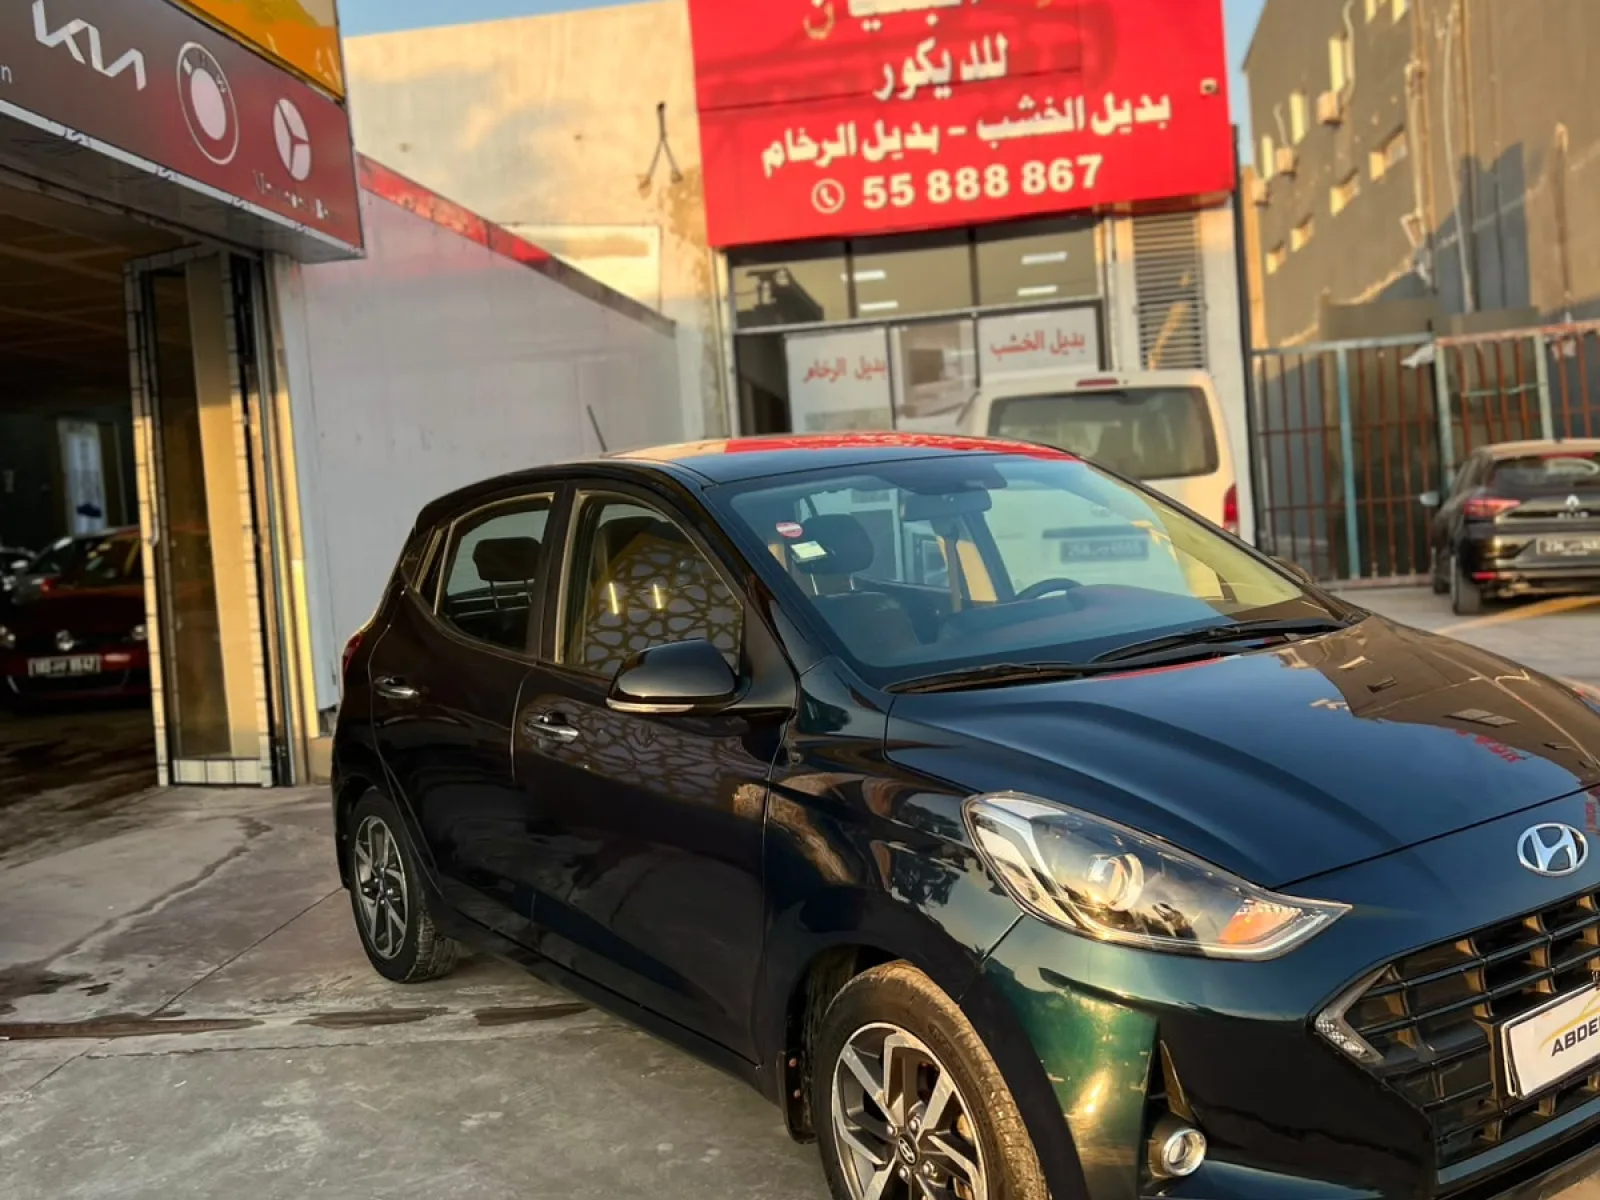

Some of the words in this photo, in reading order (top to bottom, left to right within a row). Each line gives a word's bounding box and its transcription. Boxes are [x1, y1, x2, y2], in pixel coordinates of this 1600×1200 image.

[872, 32, 1008, 101] للديكور
[862, 118, 940, 162] بديل
[976, 94, 1085, 150] الخشب
[1091, 91, 1172, 136] بديل
[761, 119, 858, 179] الرخام
[863, 172, 915, 209] 55
[926, 162, 1010, 204] 888
[1021, 153, 1103, 195] 867
